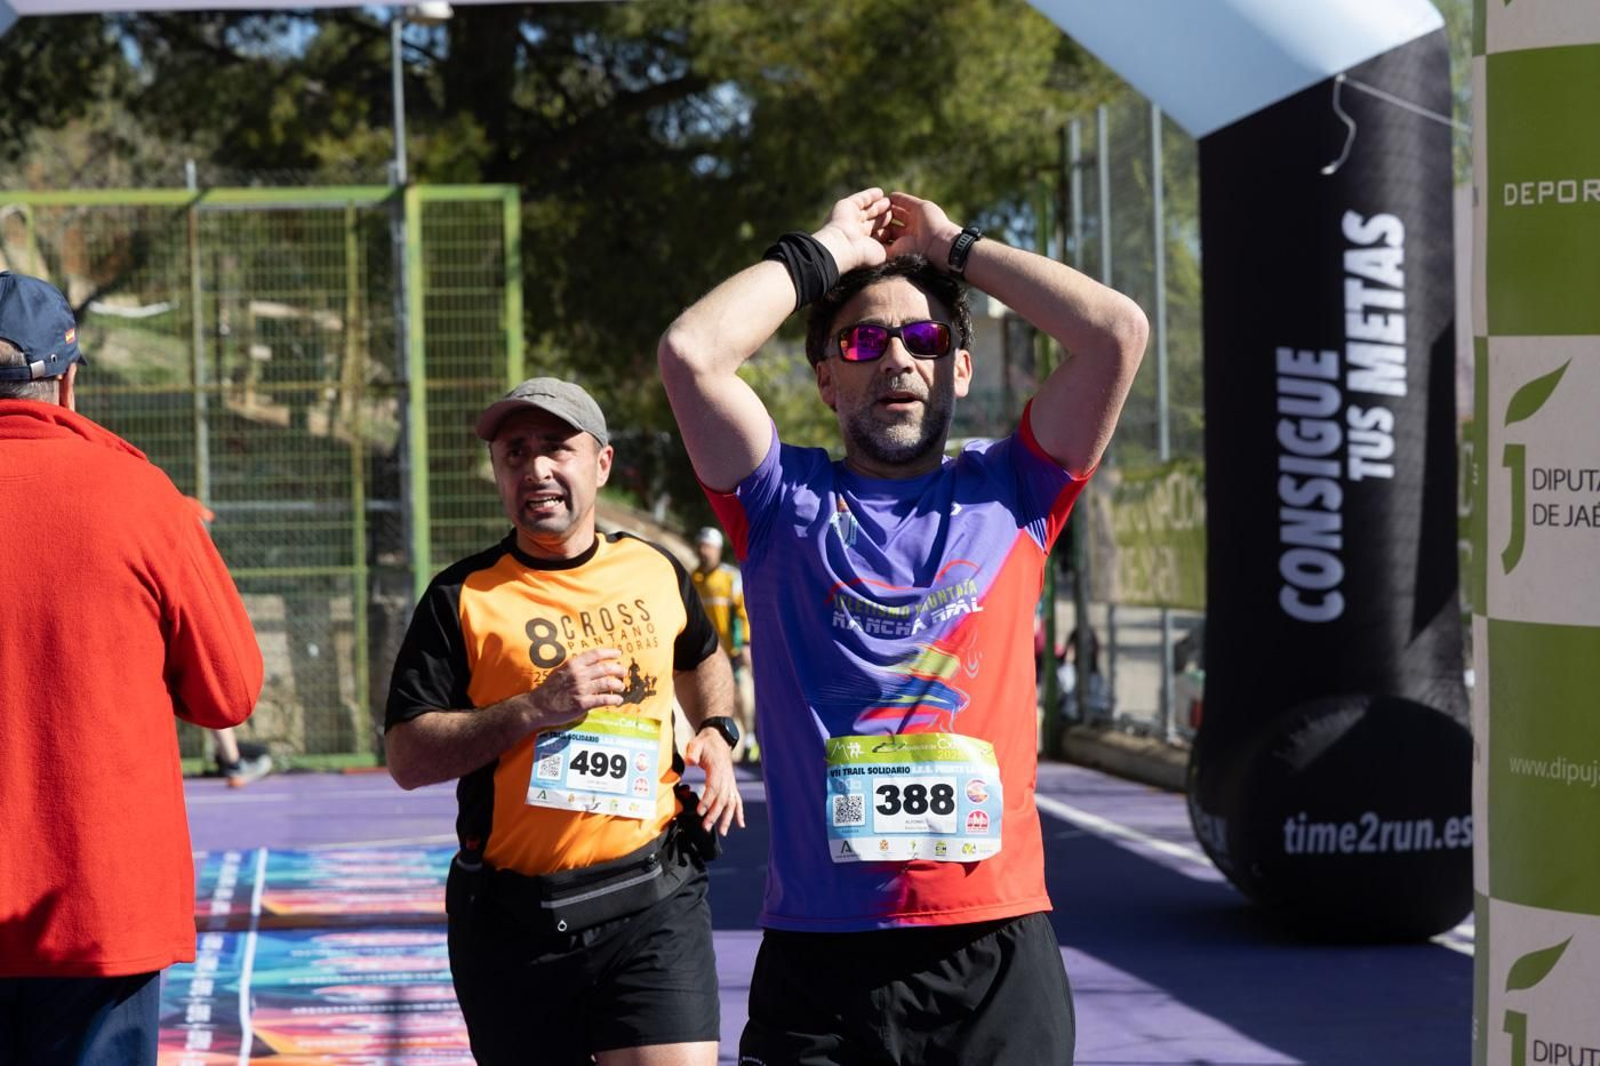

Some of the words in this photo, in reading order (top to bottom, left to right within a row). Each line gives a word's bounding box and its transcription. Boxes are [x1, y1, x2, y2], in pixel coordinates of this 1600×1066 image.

[1342, 209, 1407, 396] METAS
[1347, 404, 1395, 481] TUS
[1277, 347, 1345, 623] CONSIGUE
[1532, 468, 1600, 492] DIPUT
[1532, 503, 1559, 526] DE
[561, 599, 650, 640] CROSS
[567, 622, 655, 650] PANTANO
[525, 617, 567, 669] 8
[569, 750, 627, 779] 499
[842, 767, 865, 777] TRAIL
[867, 766, 911, 775] SOLIDARIO
[1509, 756, 1600, 788] www.dipuj
[875, 783, 955, 816] 388
[1284, 812, 1473, 854] time2run.es
